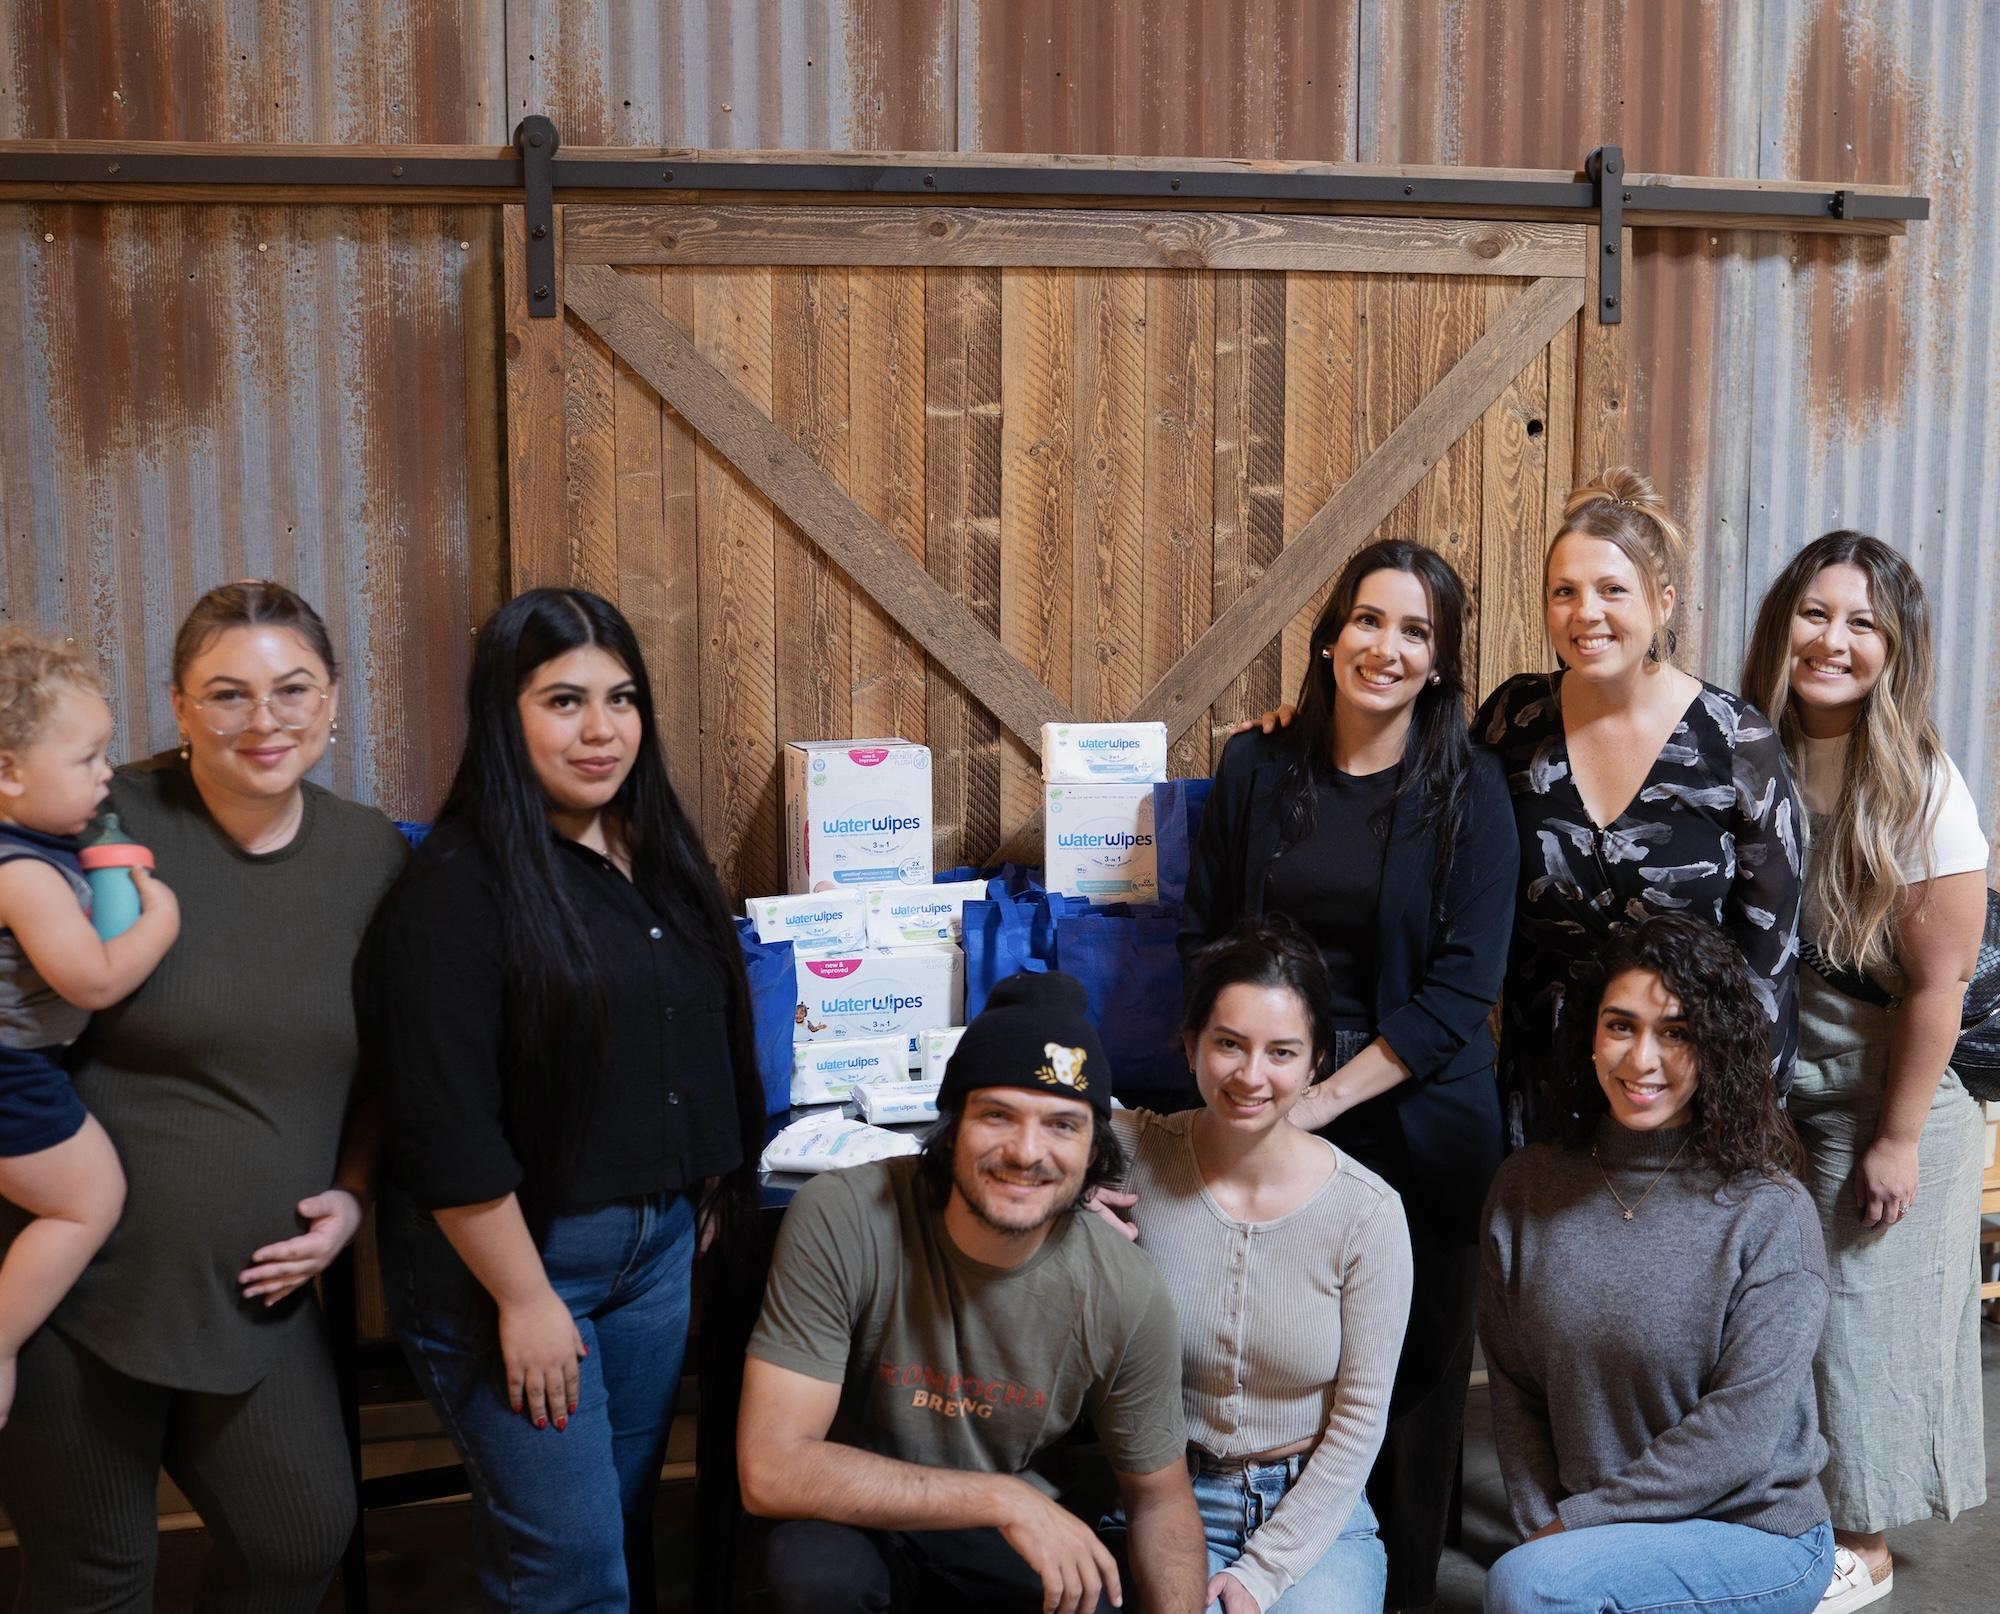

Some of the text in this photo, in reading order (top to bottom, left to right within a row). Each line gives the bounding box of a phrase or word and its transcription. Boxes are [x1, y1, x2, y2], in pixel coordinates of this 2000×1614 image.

[822, 814, 921, 835] WaterWipes
[1057, 831, 1153, 850] WaterWipes
[820, 966, 849, 976] improved
[821, 993, 924, 1014] WaterWipes
